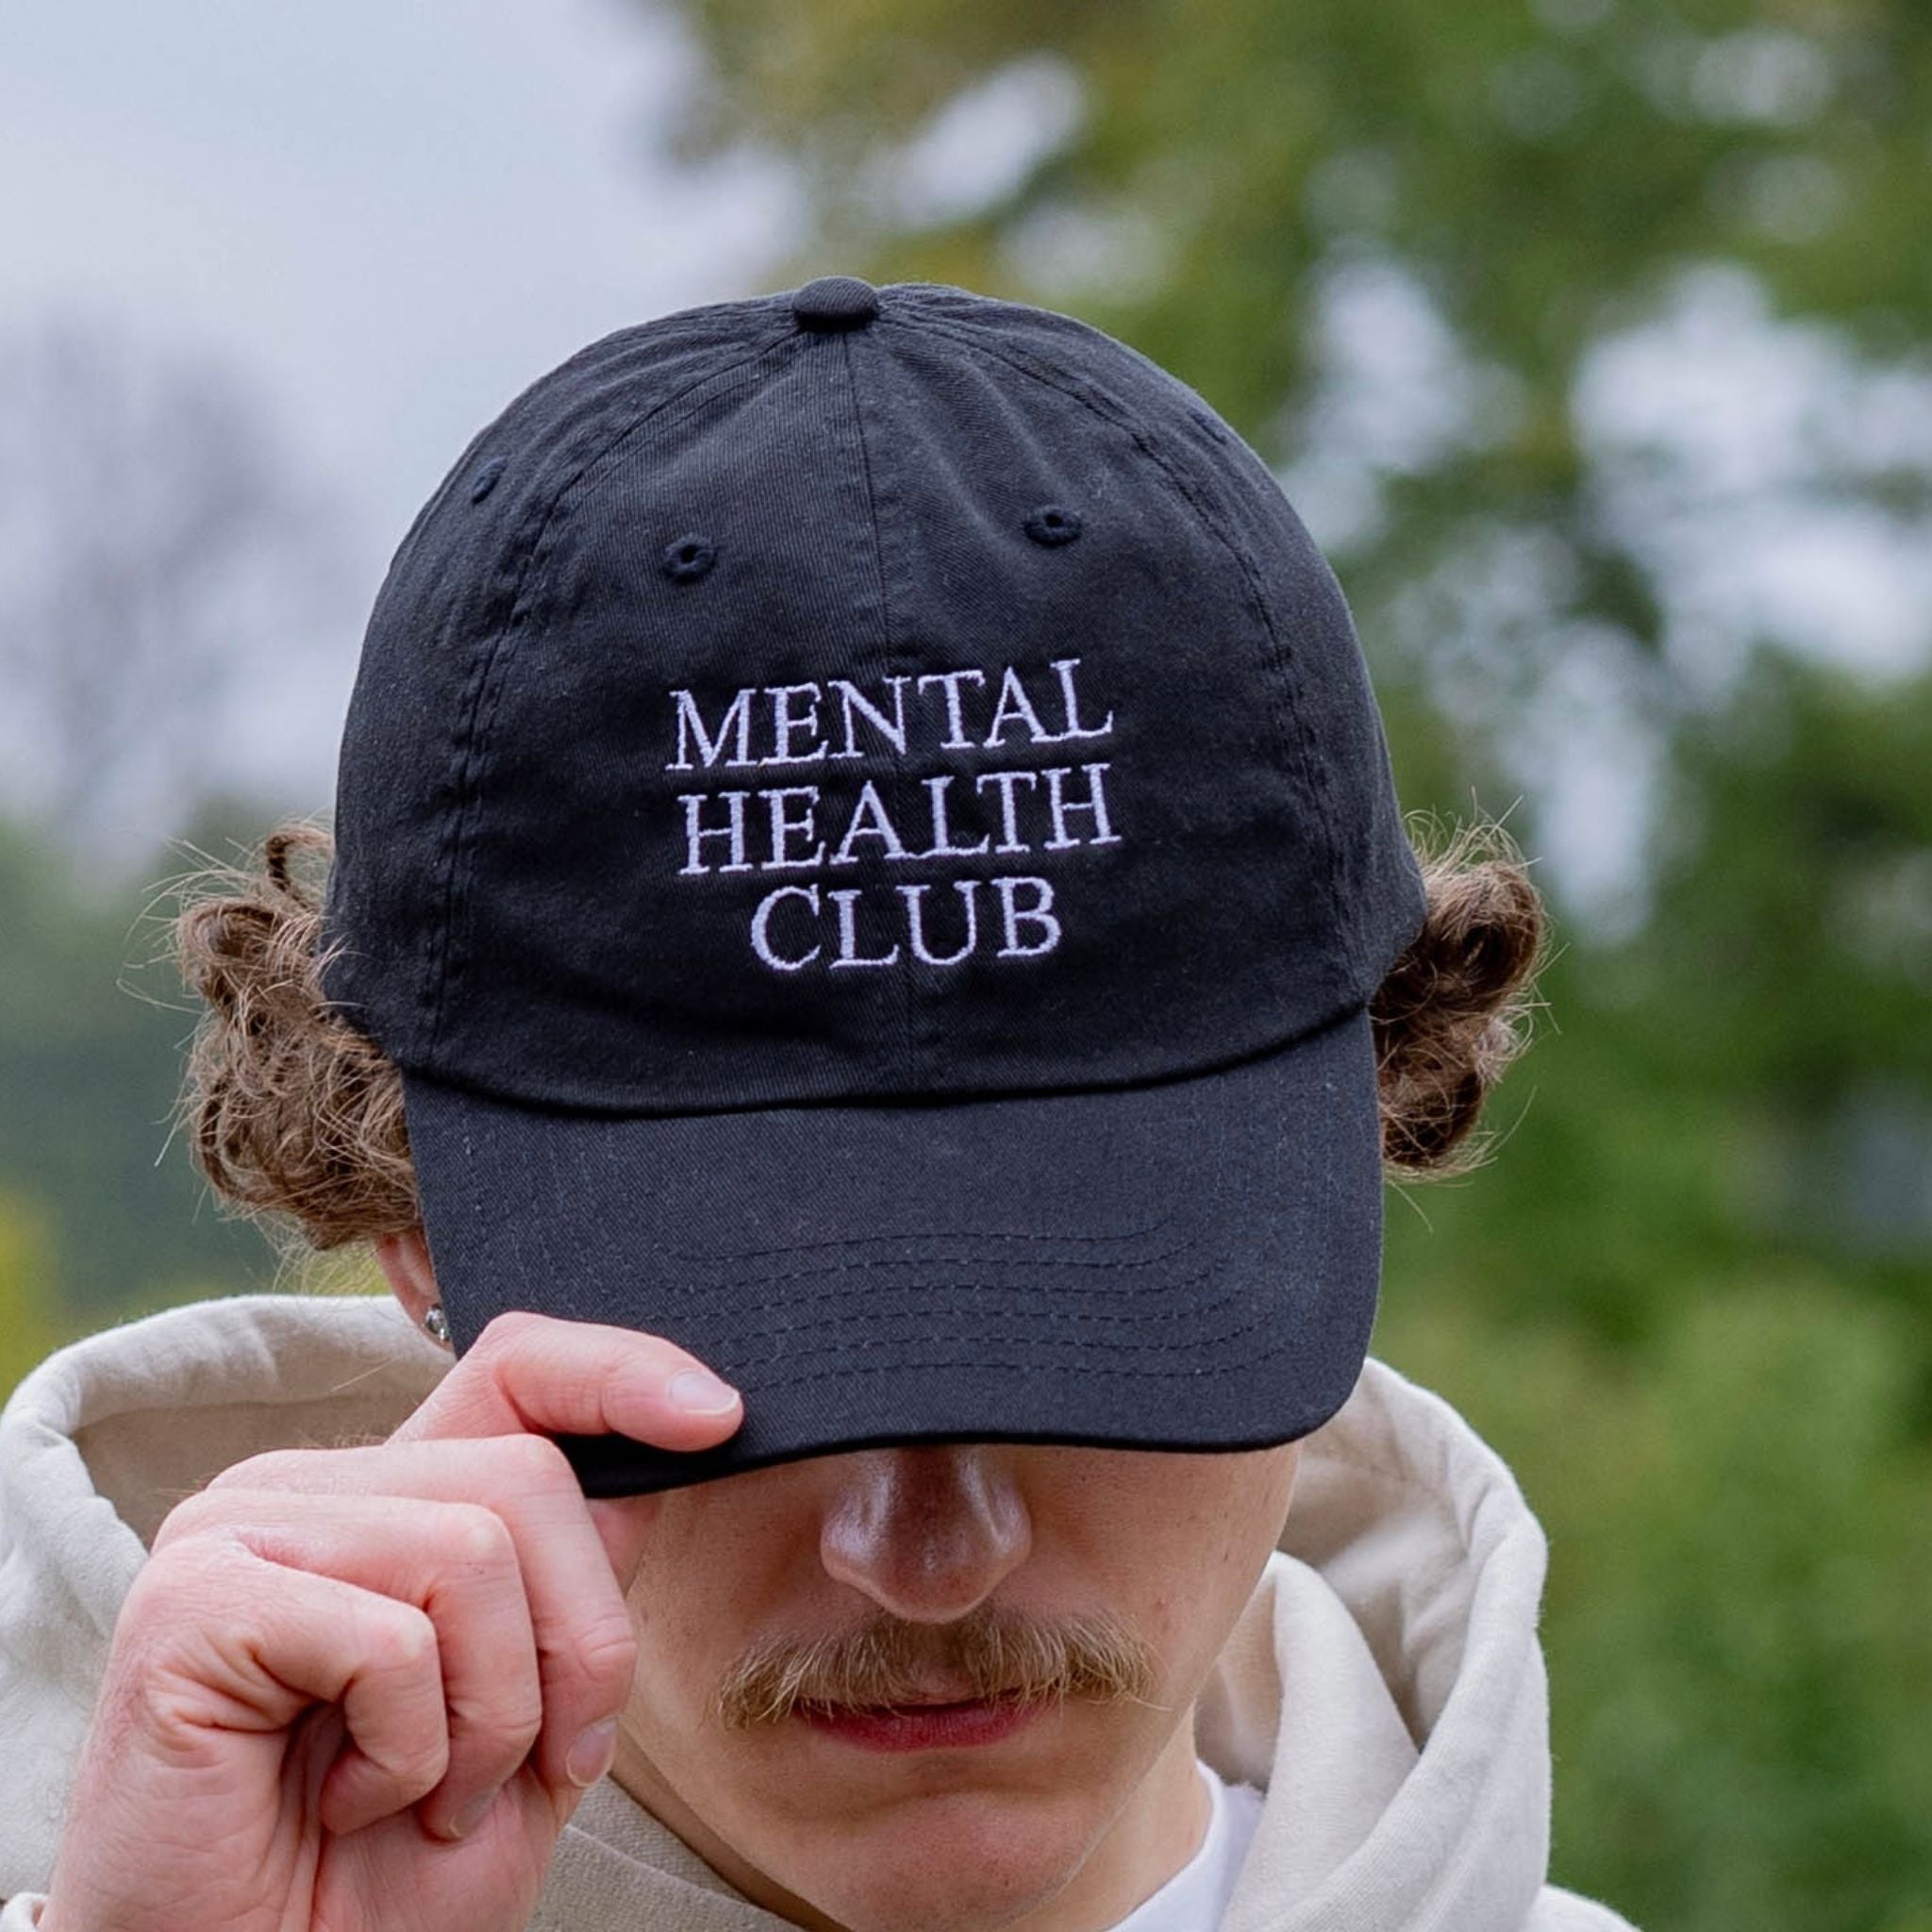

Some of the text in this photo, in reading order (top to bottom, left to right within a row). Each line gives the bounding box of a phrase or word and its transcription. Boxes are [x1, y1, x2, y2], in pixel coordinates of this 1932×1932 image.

[665, 658, 1113, 771] MENTAL
[677, 762, 1122, 875] HEALTH
[750, 876, 1062, 972] CLUB
